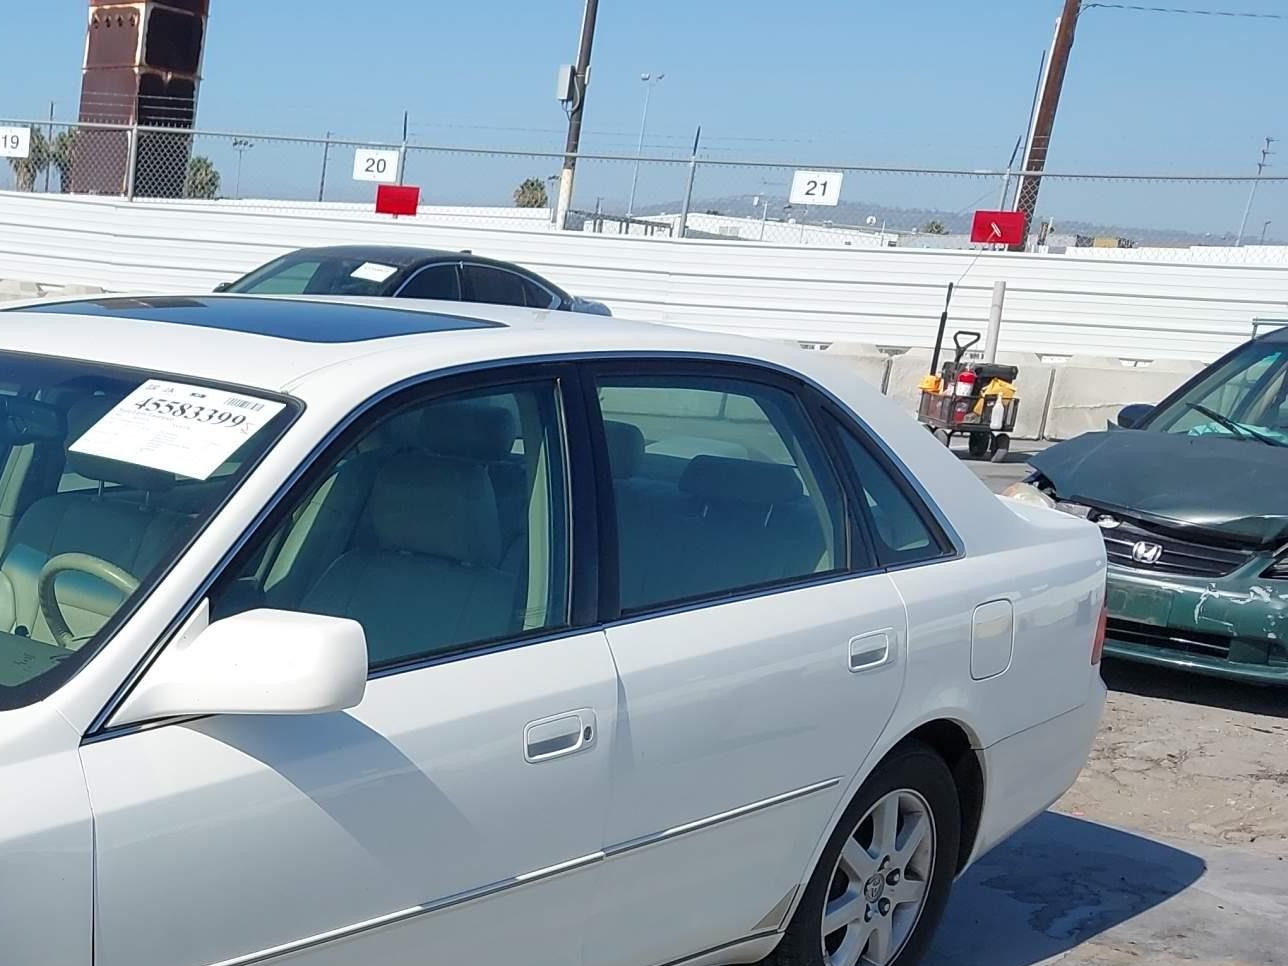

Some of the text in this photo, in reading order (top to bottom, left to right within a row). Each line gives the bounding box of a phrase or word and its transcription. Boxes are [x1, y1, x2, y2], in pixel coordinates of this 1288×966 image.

[1, 134, 20, 149] 19
[364, 158, 387, 173] 20
[804, 180, 828, 196] 21
[133, 397, 247, 428] 45583399
